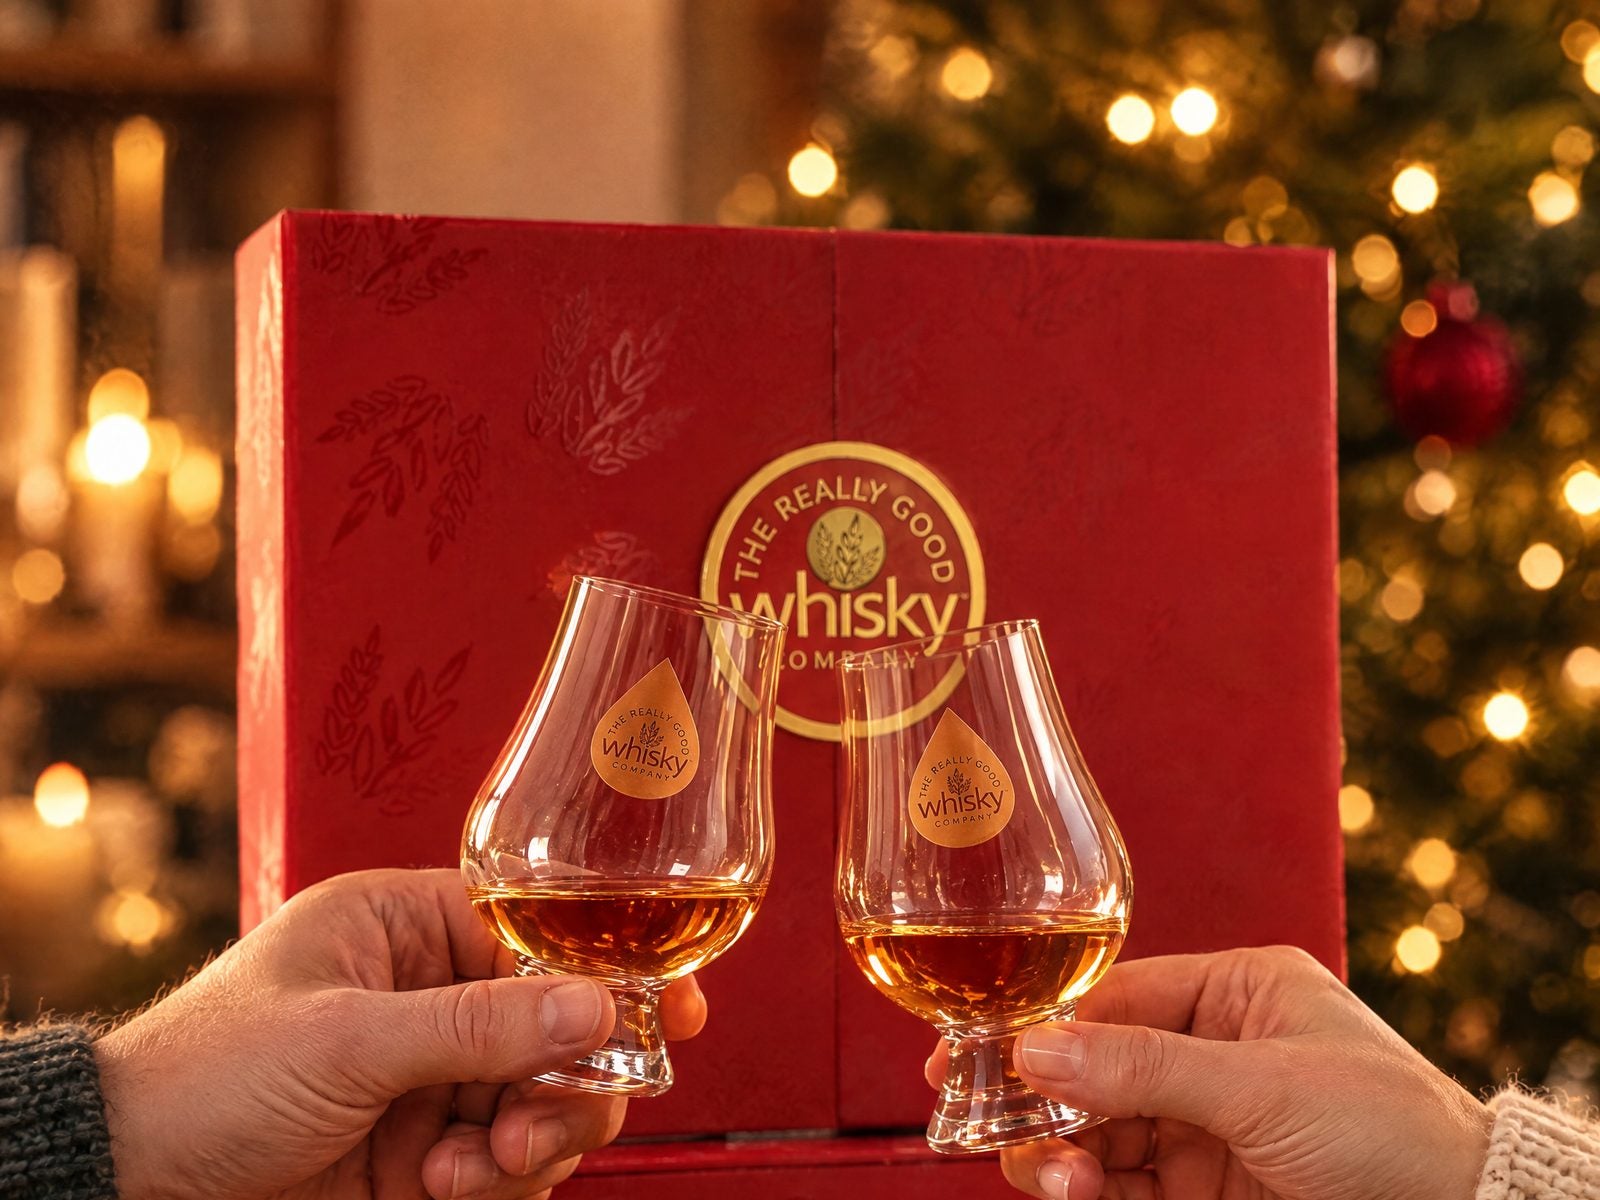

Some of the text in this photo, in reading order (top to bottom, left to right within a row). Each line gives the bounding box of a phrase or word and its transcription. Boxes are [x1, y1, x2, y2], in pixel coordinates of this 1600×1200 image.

[735, 475, 955, 583] THE REALLY GOOD
[729, 570, 962, 657] whisky
[607, 707, 690, 756] THE REALLY GOOD
[602, 736, 689, 779] whisky
[612, 761, 670, 781] COMPANY
[919, 756, 1001, 799] THE REALLY GOOD
[917, 786, 1004, 819] whisky
[934, 813, 992, 828] COMPANY
